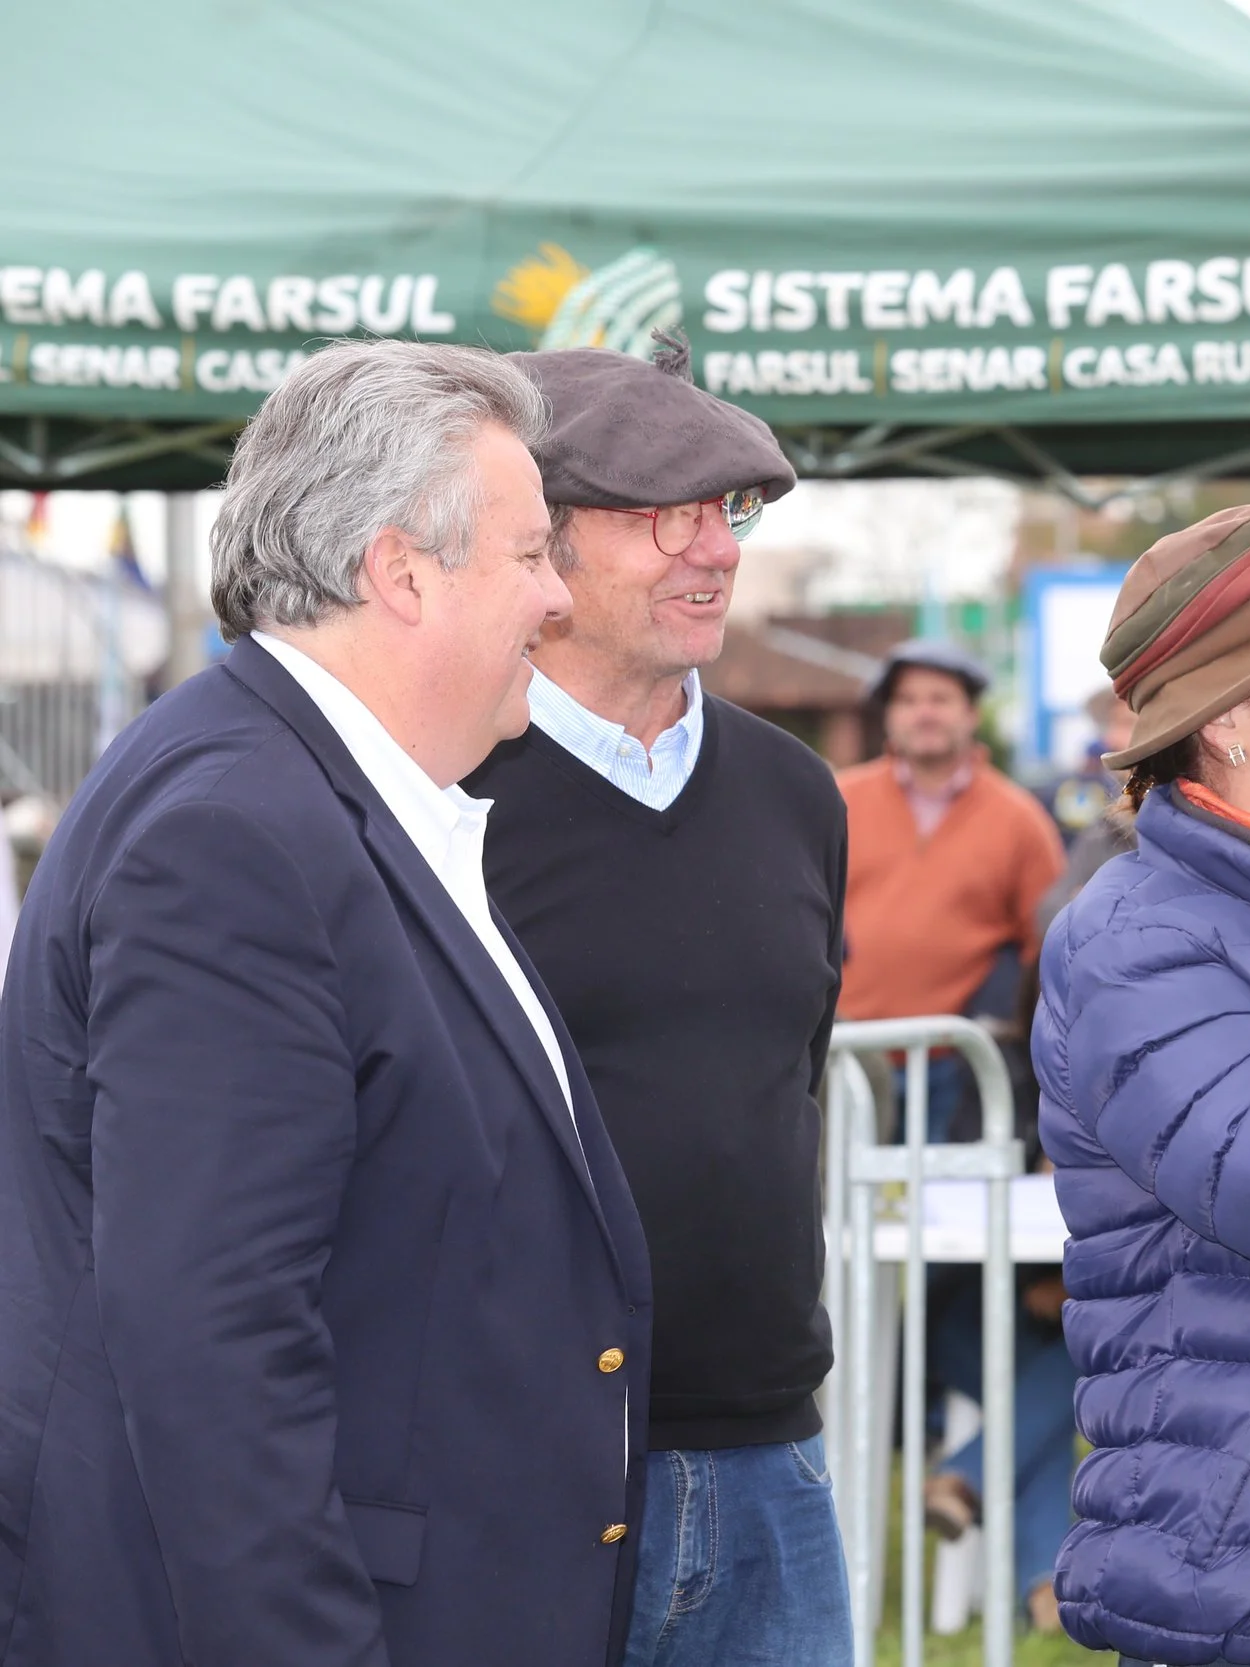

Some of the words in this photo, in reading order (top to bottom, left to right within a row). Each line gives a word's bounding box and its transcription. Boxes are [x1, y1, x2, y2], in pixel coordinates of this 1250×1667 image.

[172, 273, 456, 334] FARSUL
[704, 267, 1033, 332] SISTEMA
[30, 342, 182, 389] SENAR
[704, 350, 872, 395] FARSUL
[890, 346, 1047, 391] SENAR
[1063, 342, 1189, 387] CASA
